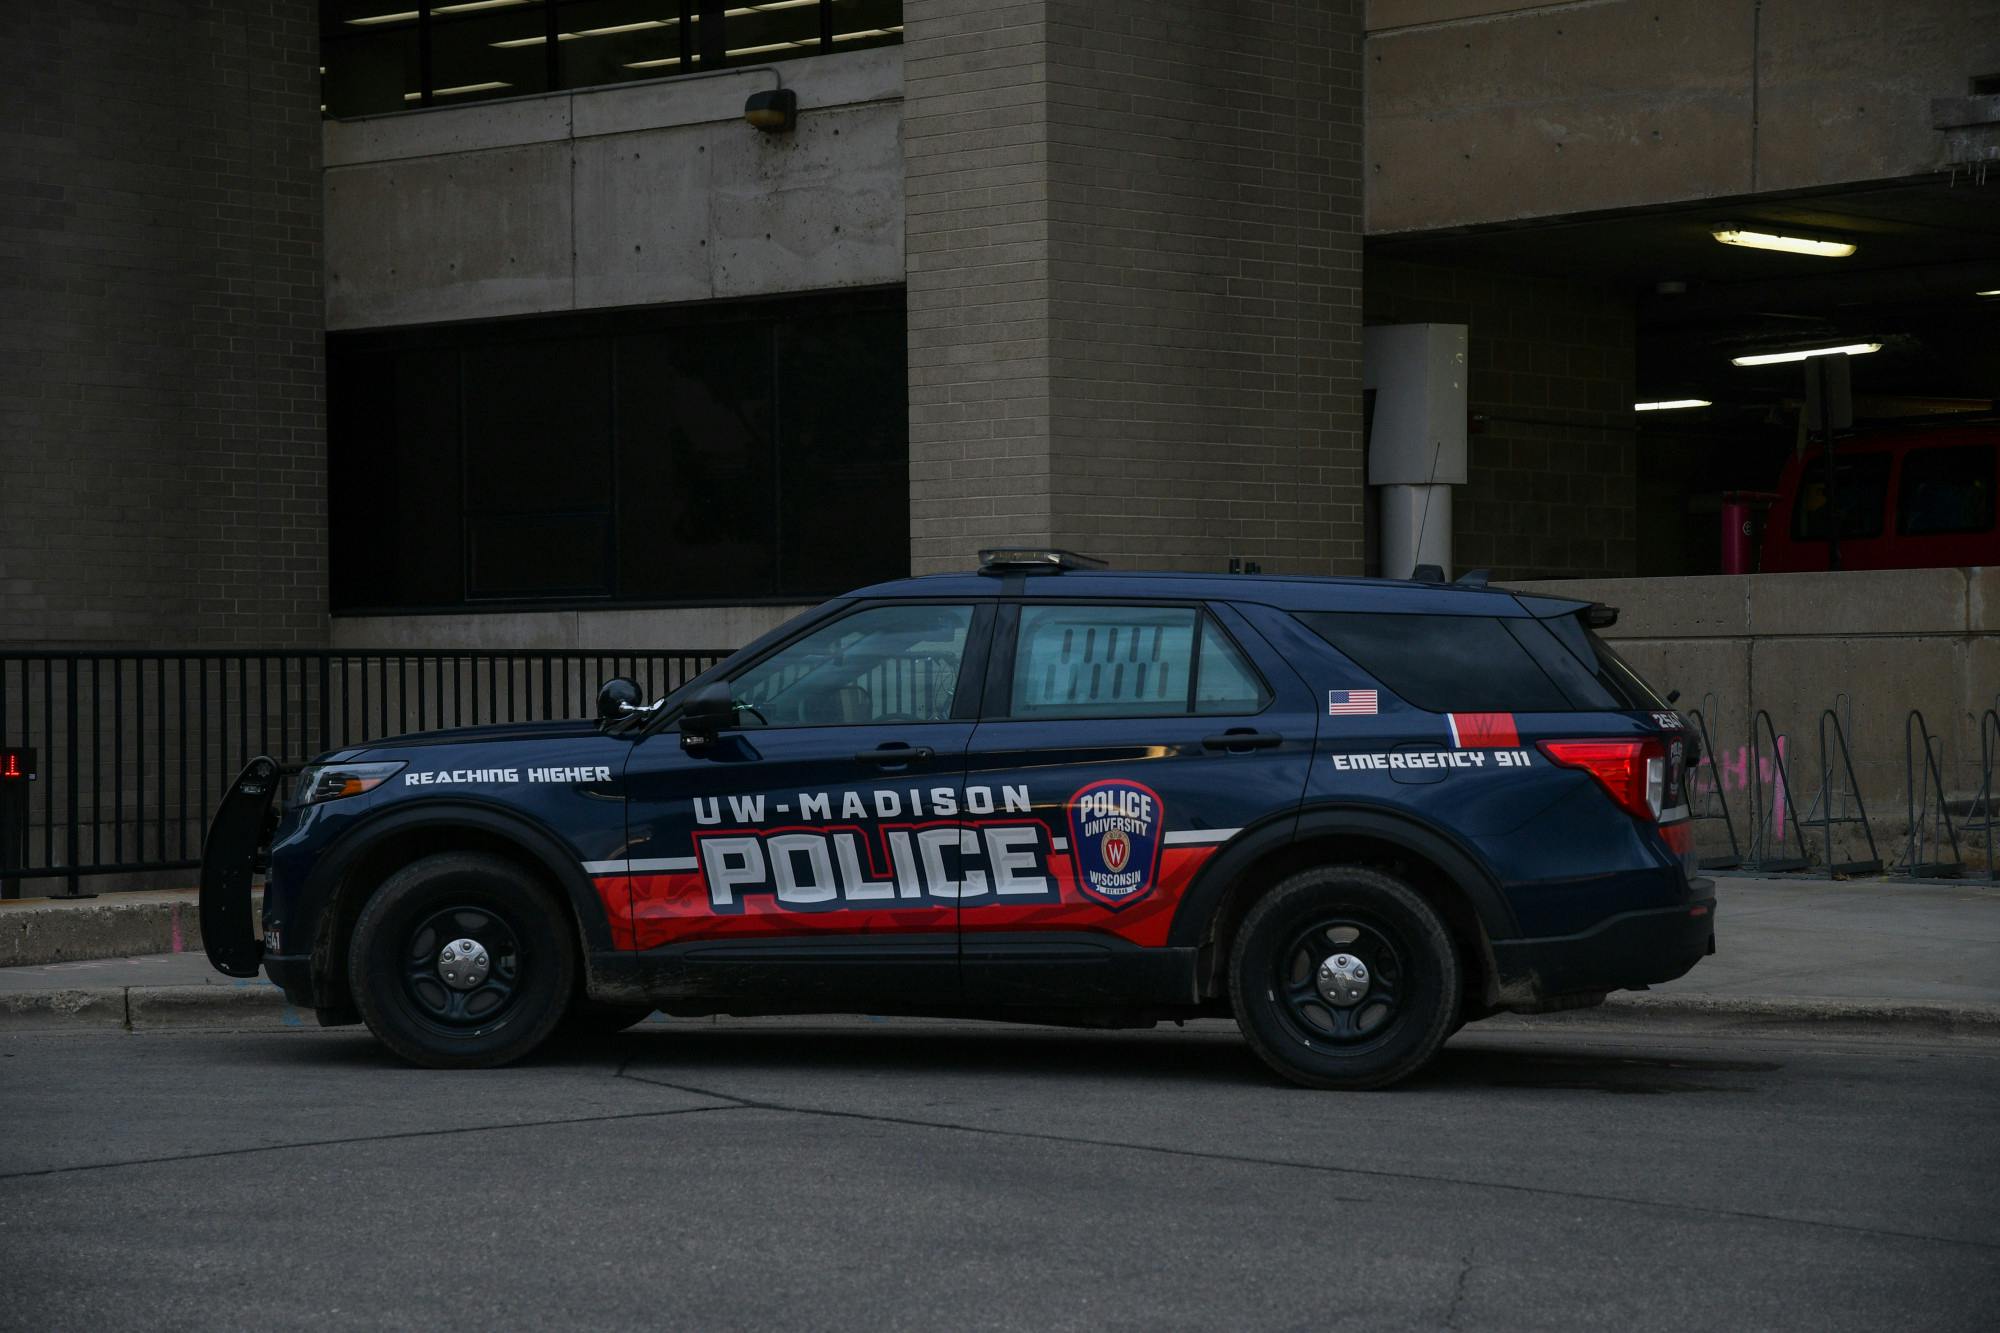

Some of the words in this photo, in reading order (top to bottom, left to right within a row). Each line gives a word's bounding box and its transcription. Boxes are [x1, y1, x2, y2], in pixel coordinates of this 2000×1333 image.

[1332, 751, 1486, 771] EMERGENCY
[1493, 751, 1532, 767] 911
[405, 768, 519, 786] REACHING
[527, 766, 613, 783] HIGHER
[692, 784, 1032, 825] UW-MADISON
[1080, 789, 1152, 824] POLICE
[1084, 817, 1148, 838] UNIVERSITY
[1107, 842, 1124, 865] W
[700, 825, 1049, 905] POLICE
[1089, 869, 1142, 887] WISCONSIN
